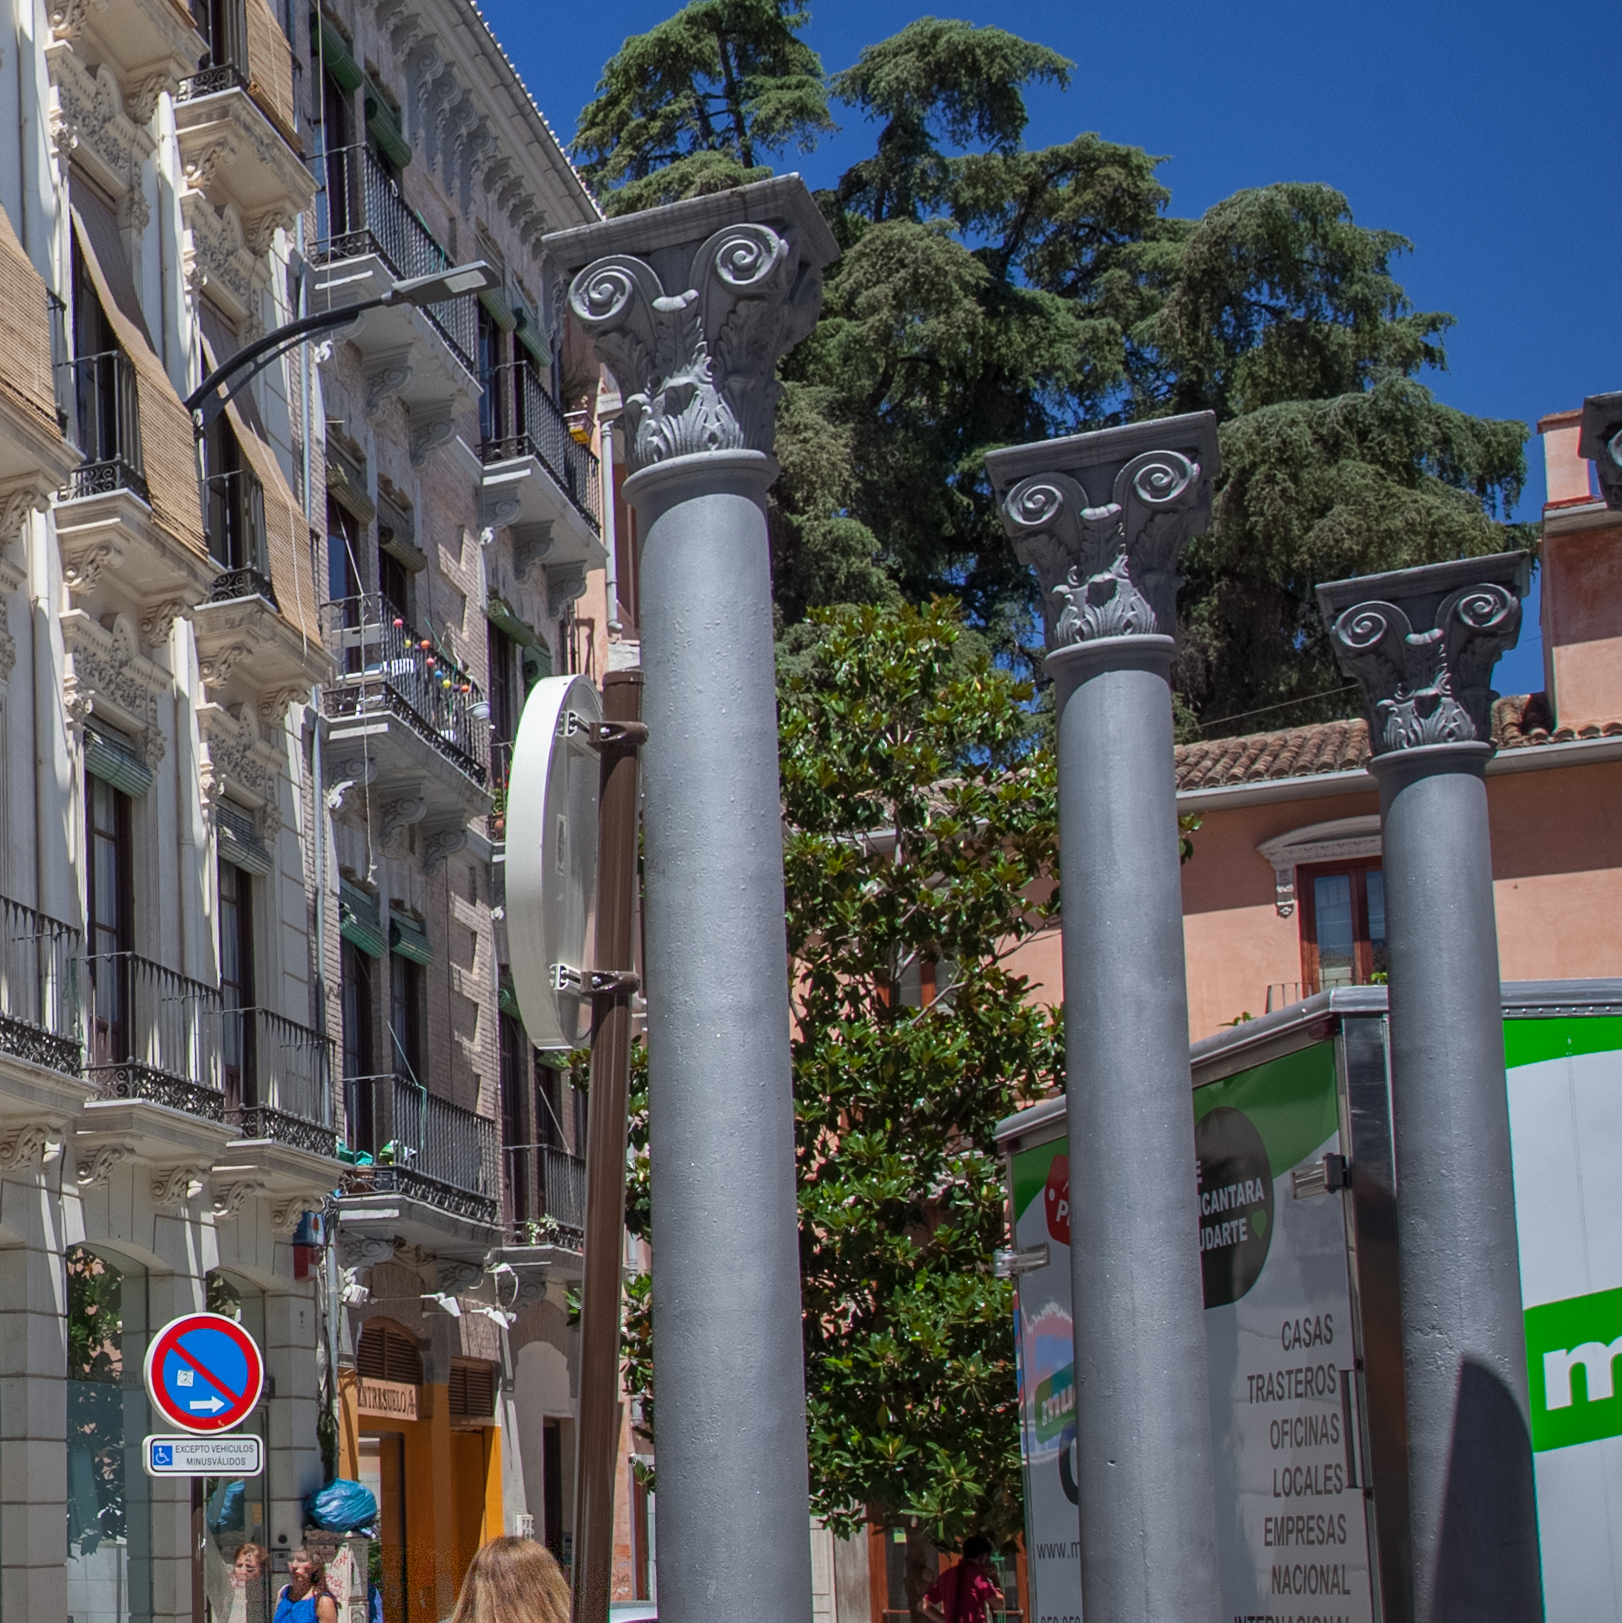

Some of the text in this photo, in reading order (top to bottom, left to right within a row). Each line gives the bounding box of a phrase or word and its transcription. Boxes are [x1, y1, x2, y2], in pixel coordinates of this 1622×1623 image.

[1281, 1313, 1333, 1351] CASAS
[1247, 1363, 1336, 1405] TRASTEROS
[1542, 1335, 1622, 1411] m
[358, 1385, 407, 1413] ENTRESUELO
[1270, 1413, 1340, 1450] OFICINAS
[175, 1443, 254, 1454] EXCEPTO VEHÍCULOS
[186, 1456, 246, 1466] MINUSVÁLIDOS
[1273, 1463, 1343, 1498] LOCALES
[1264, 1514, 1347, 1547] EMPRESAS
[1036, 1542, 1081, 1559] www.m
[1271, 1564, 1351, 1595] NACIONAL
